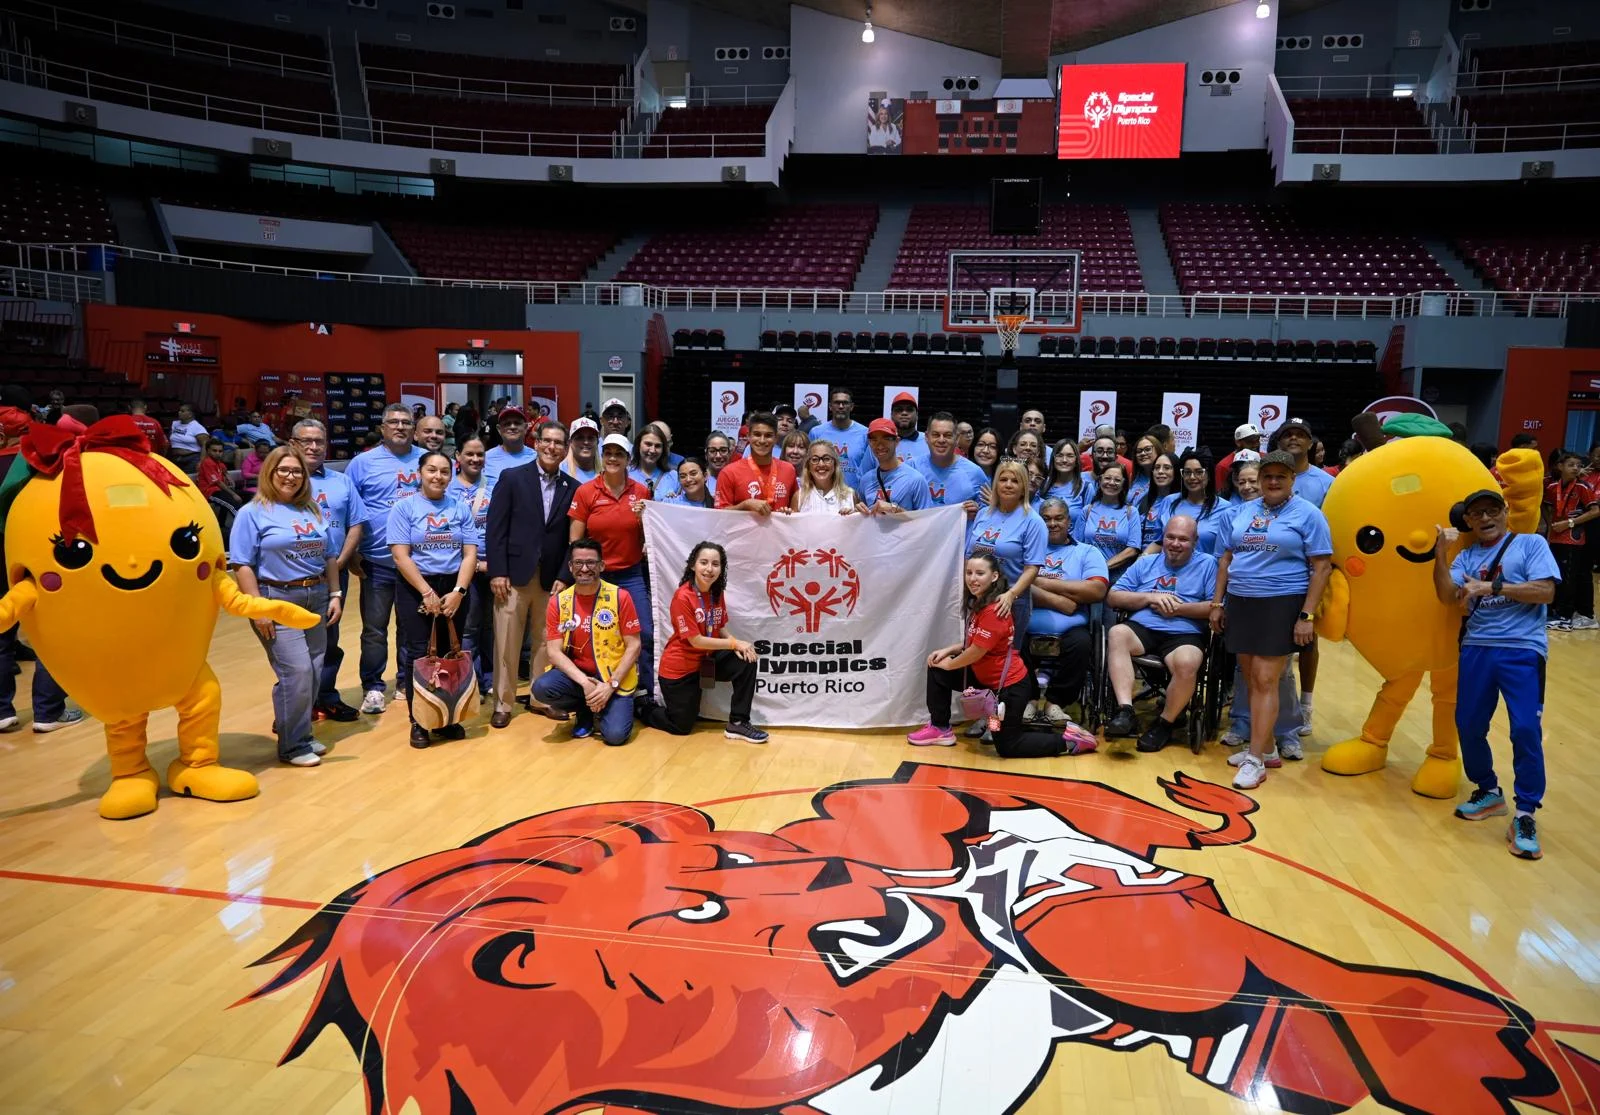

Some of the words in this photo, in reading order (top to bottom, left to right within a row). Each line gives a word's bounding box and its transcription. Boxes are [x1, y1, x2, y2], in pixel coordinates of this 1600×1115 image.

[1118, 92, 1154, 103] Special
[1113, 104, 1158, 115] Olympics
[1117, 116, 1137, 125] Puerto
[1138, 116, 1151, 125] Rico
[1523, 420, 1540, 429] EXIT
[754, 640, 862, 657] Special
[759, 658, 887, 675] lympics
[755, 679, 818, 694] Puerto
[825, 679, 865, 693] Rico
